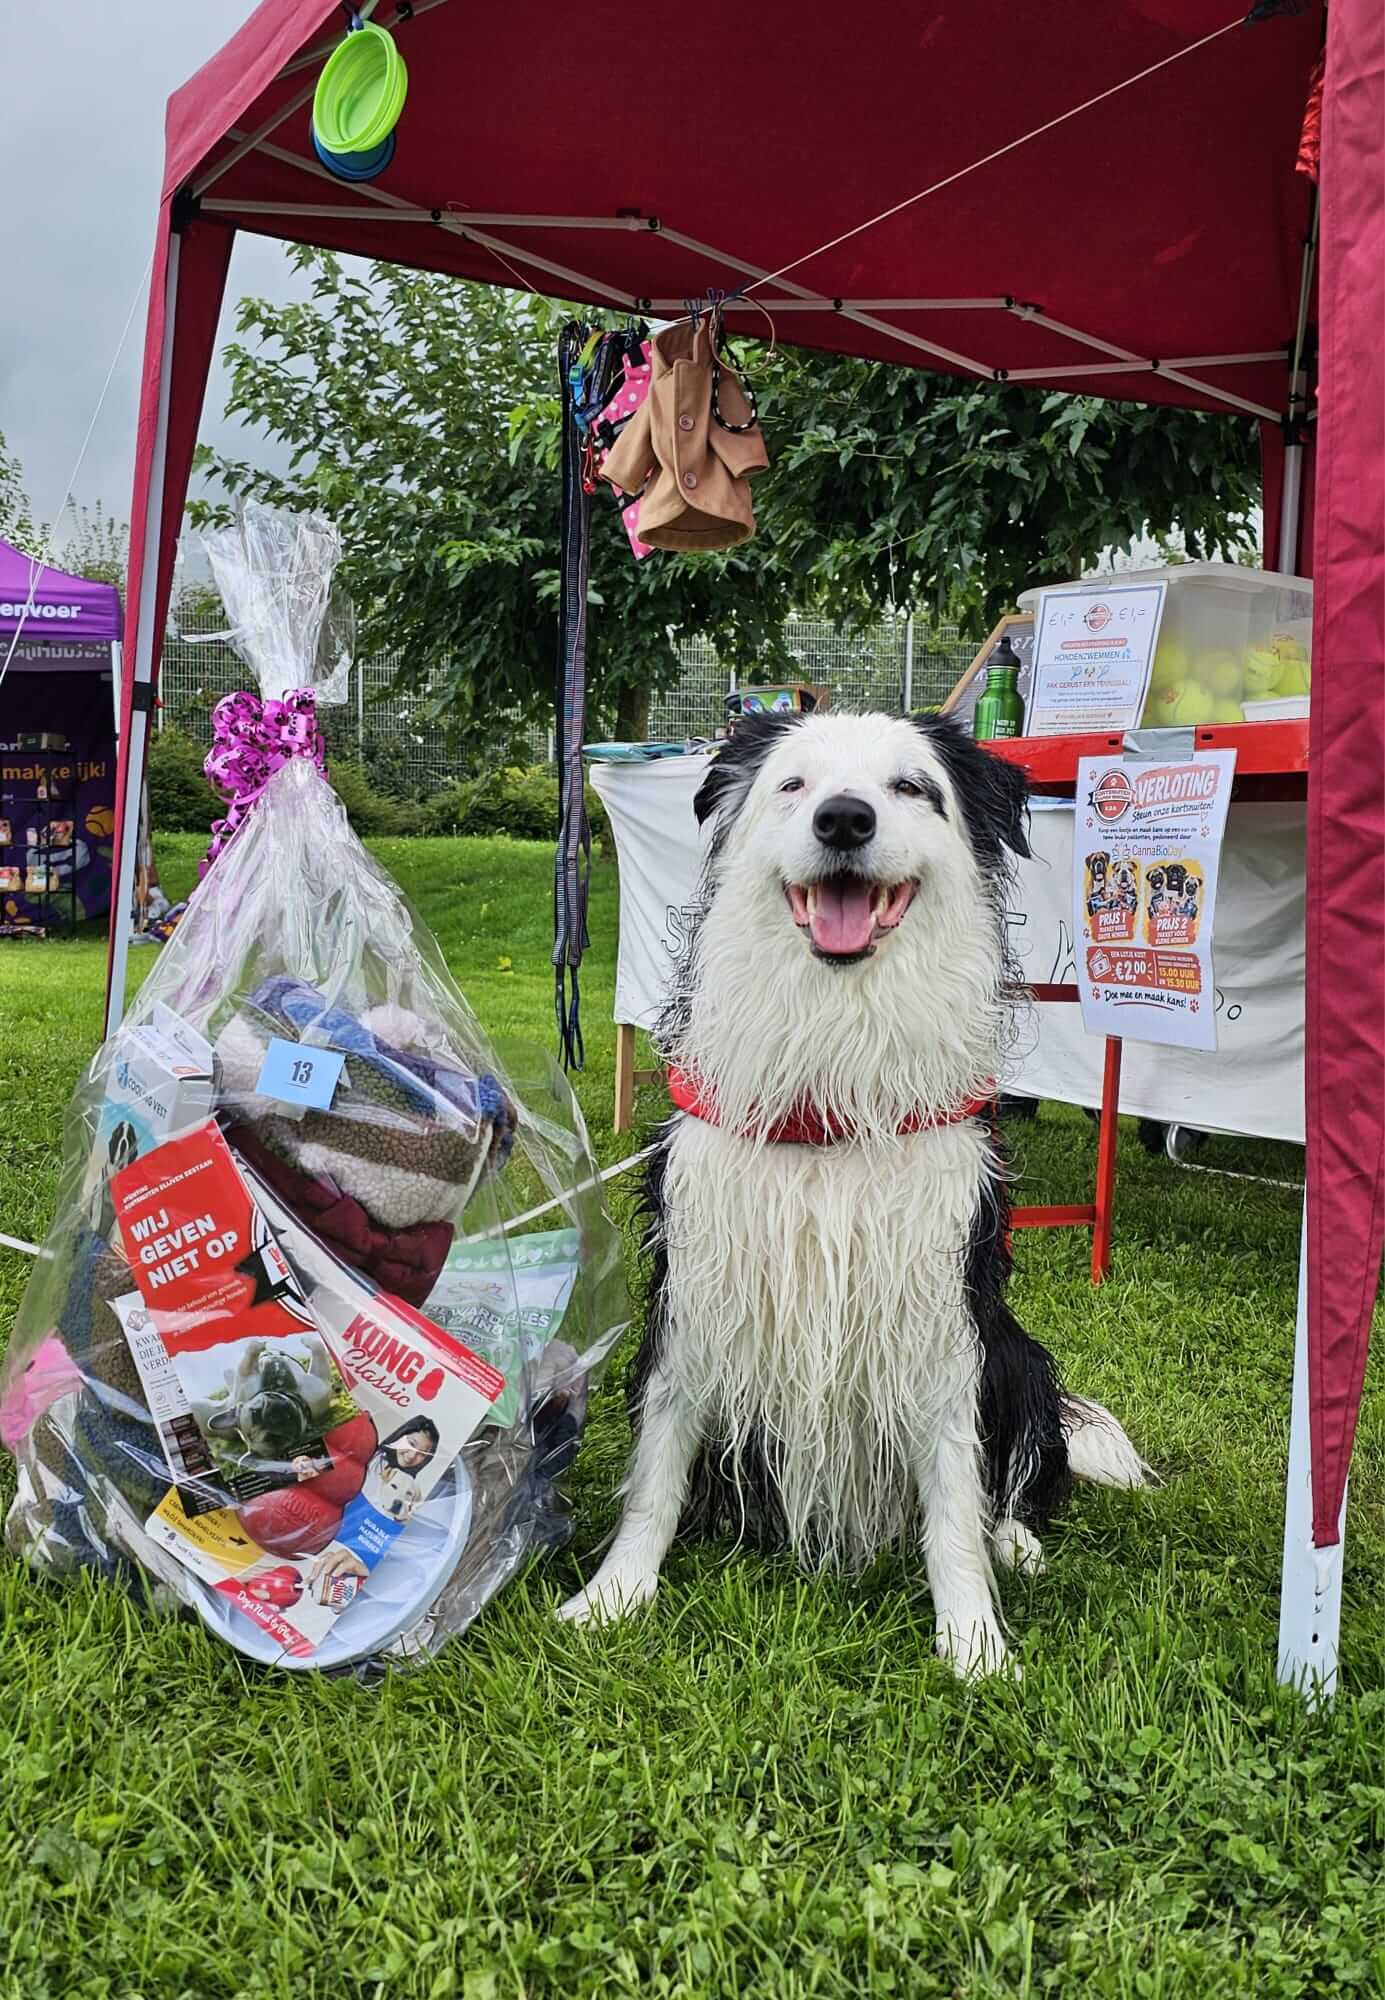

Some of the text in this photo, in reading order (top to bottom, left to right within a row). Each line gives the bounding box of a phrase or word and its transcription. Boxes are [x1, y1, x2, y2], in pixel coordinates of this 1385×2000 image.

[1137, 769, 1215, 804] VERLOTING
[1132, 809, 1152, 823] Steun
[1171, 799, 1214, 814] kortsnuiten!
[1099, 911, 1121, 927] PRIJS
[1156, 917, 1188, 931] PRIJS 2
[1179, 968, 1195, 978] UUR
[1185, 979, 1200, 990] UUR
[1104, 989, 1187, 1009] Doe mee en maak kans!
[291, 1060, 314, 1084] 13
[153, 1099, 168, 1119] VEST
[184, 1159, 214, 1177] BESTAAN
[130, 1207, 169, 1242] WIJ
[139, 1213, 216, 1265] GEVEN
[147, 1230, 238, 1289] NIET OP
[139, 1345, 156, 1360] DIE
[341, 1312, 425, 1384] KONG
[341, 1349, 411, 1408] Classic
[329, 1579, 346, 1605] KONG
